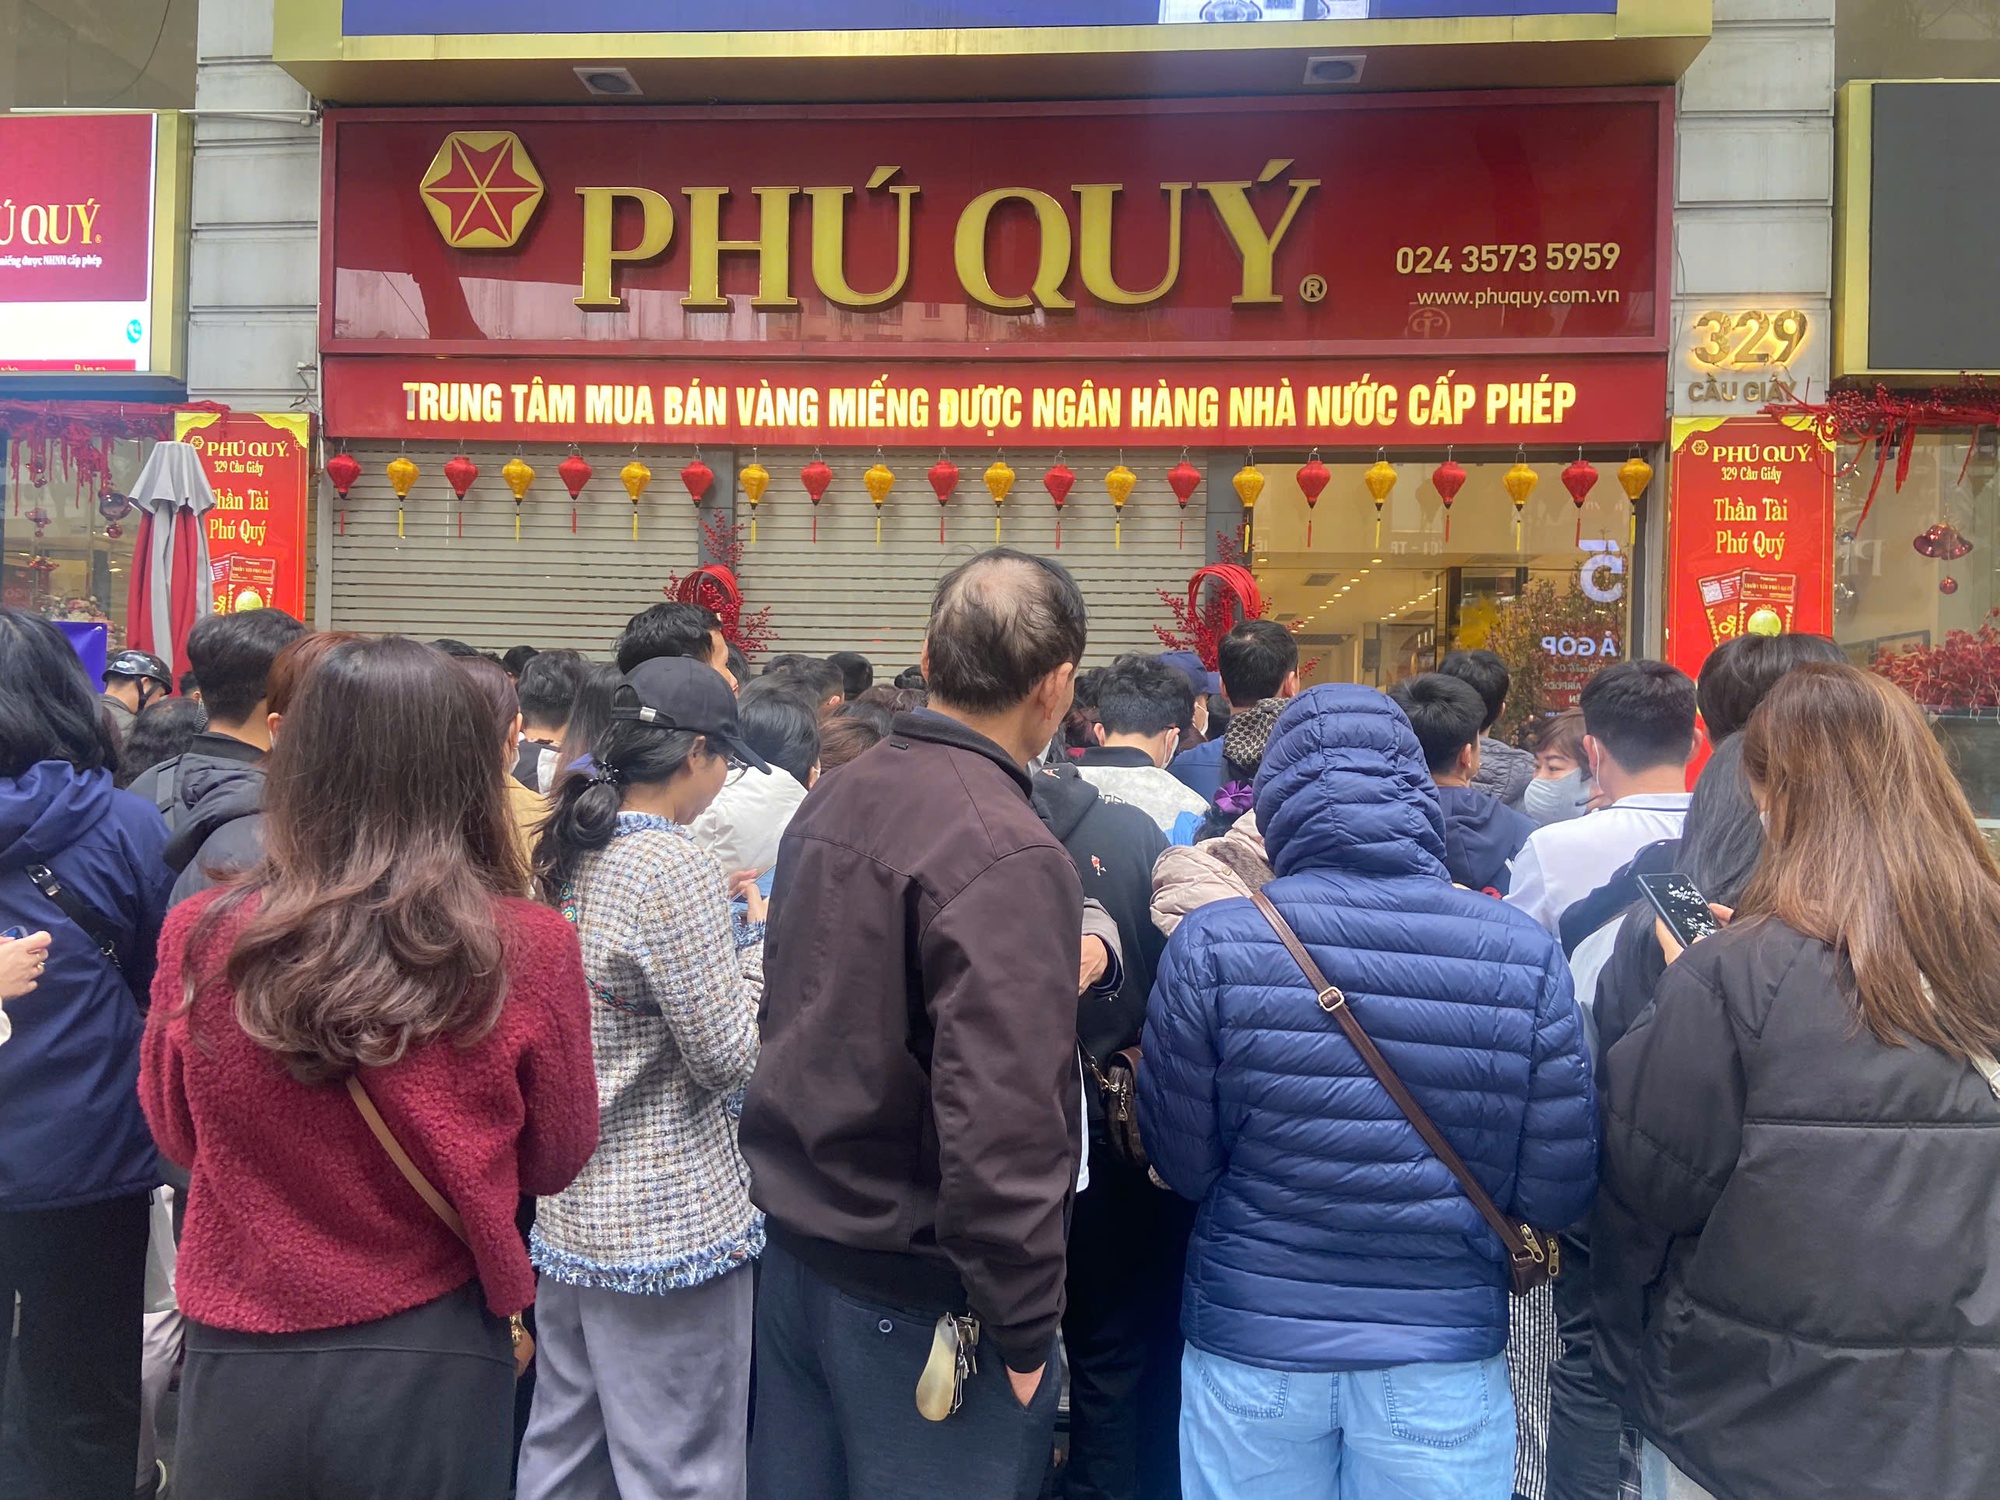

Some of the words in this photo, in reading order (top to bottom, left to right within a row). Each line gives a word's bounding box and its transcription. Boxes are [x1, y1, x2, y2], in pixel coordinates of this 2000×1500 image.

[21, 198, 100, 245] QUÝ
[573, 166, 920, 307] PHÚ
[954, 159, 1321, 308] QUÝ
[1396, 247, 1452, 274] 024
[1461, 244, 1537, 273] 3573
[1546, 243, 1620, 271] 5959
[1417, 287, 1619, 308] www.phuquy.com.vn
[1694, 311, 1808, 364] 329
[1688, 373, 1738, 402] CẦU
[402, 383, 502, 421] TRUNG
[511, 376, 575, 424] TÂM
[585, 385, 654, 425] MUA
[664, 379, 727, 426] BÁN
[736, 379, 819, 427] VÀNG
[828, 374, 929, 428] MIẾNG
[938, 384, 1022, 437] ĐƯỢC
[1032, 379, 1121, 428] NGÂN
[1131, 379, 1219, 428] HÀNG
[1229, 379, 1297, 427] NHÀ
[1307, 373, 1398, 426] NƯỚC
[1408, 370, 1475, 426] CẤP
[1486, 374, 1576, 424] PHÉP
[207, 440, 245, 457] PHÚ
[248, 440, 288, 457] QUÝ
[1712, 444, 1760, 462] PHÚ
[1763, 443, 1811, 462] QUÝ
[214, 461, 228, 473] 329
[1721, 467, 1738, 480] 329
[1740, 466, 1758, 480] Cầu
[1761, 466, 1781, 484] Giấy
[248, 489, 269, 510] Tài
[1713, 497, 1757, 521] Thần
[1762, 497, 1788, 521] Tài
[209, 518, 236, 539] Phú
[240, 519, 266, 546] Quý
[1716, 530, 1748, 553] Phú
[1752, 530, 1785, 560] Quý
